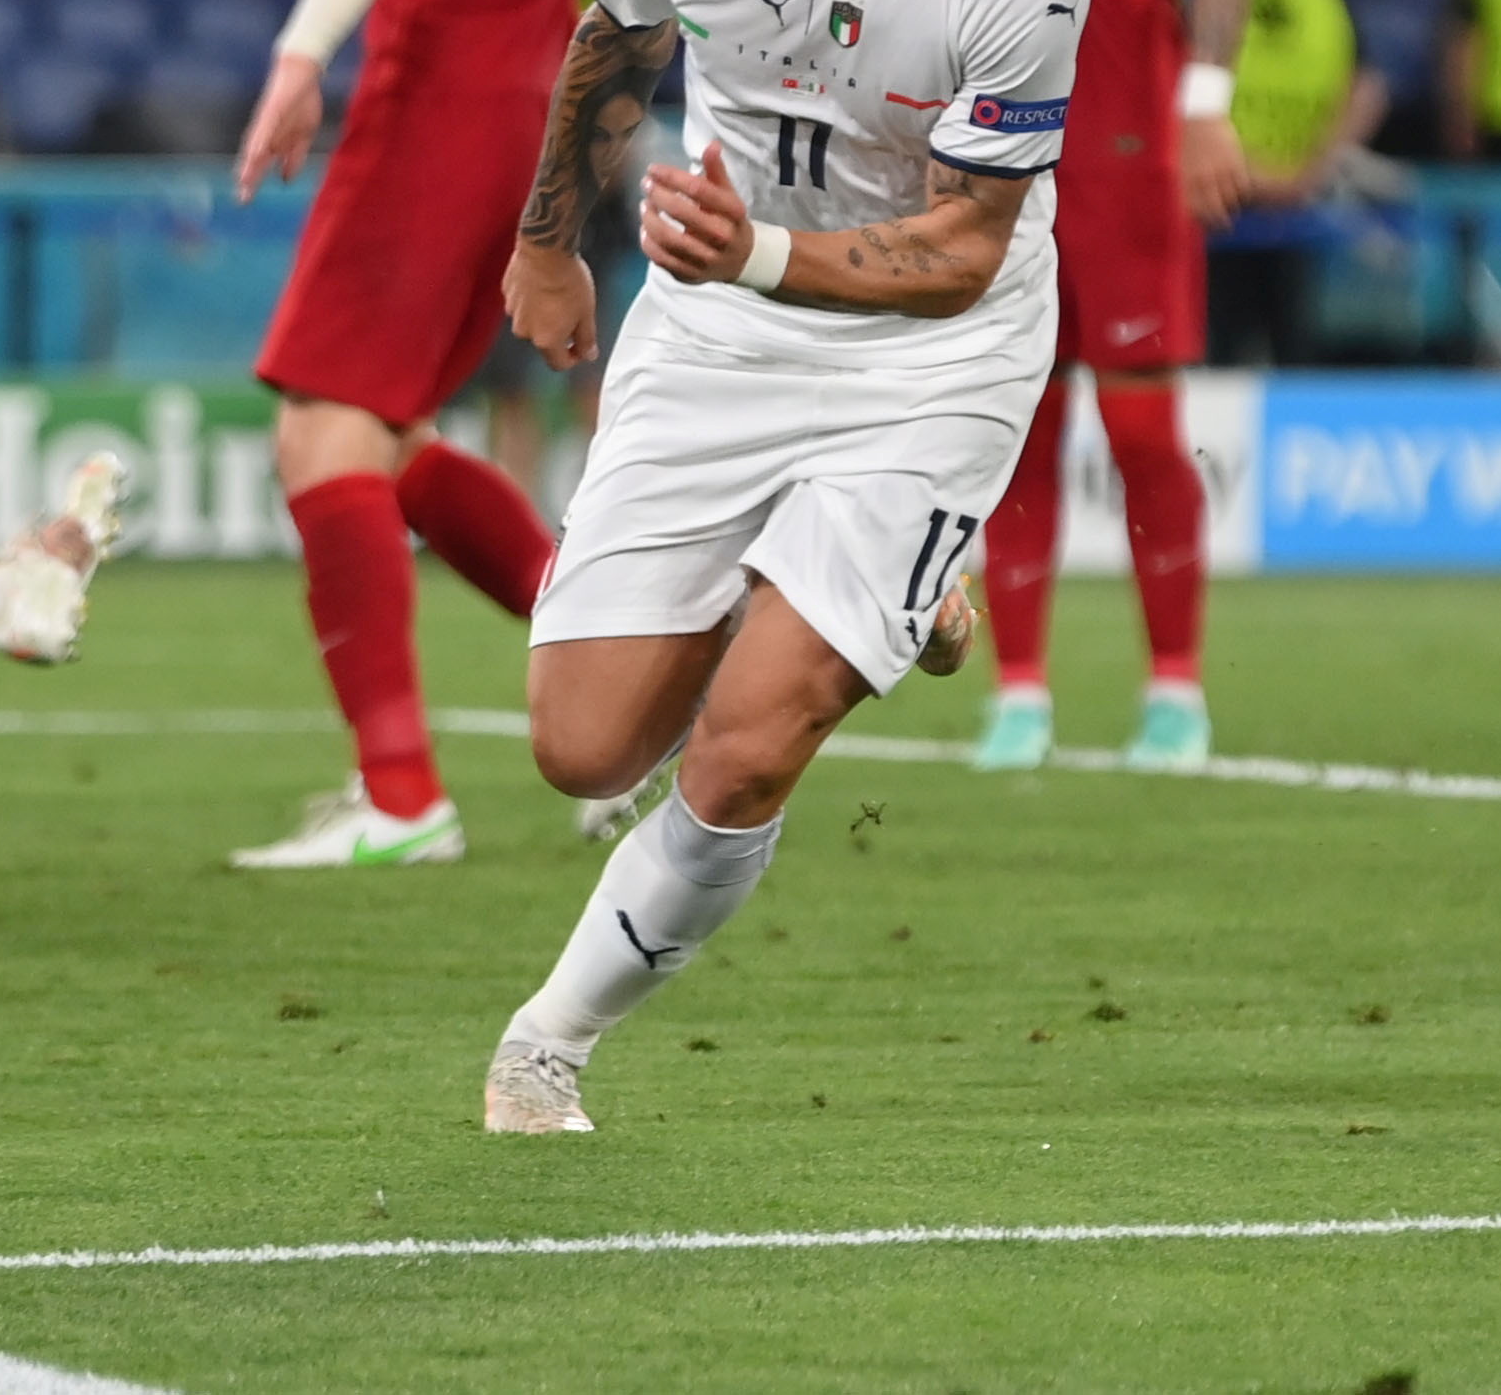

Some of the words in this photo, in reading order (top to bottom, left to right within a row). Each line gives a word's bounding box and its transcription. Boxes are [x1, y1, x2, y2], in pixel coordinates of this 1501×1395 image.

[738, 43, 856, 88] ITALIA
[1002, 105, 1067, 124] RESPECT
[778, 114, 833, 191] 11
[1279, 425, 1444, 523] PAY
